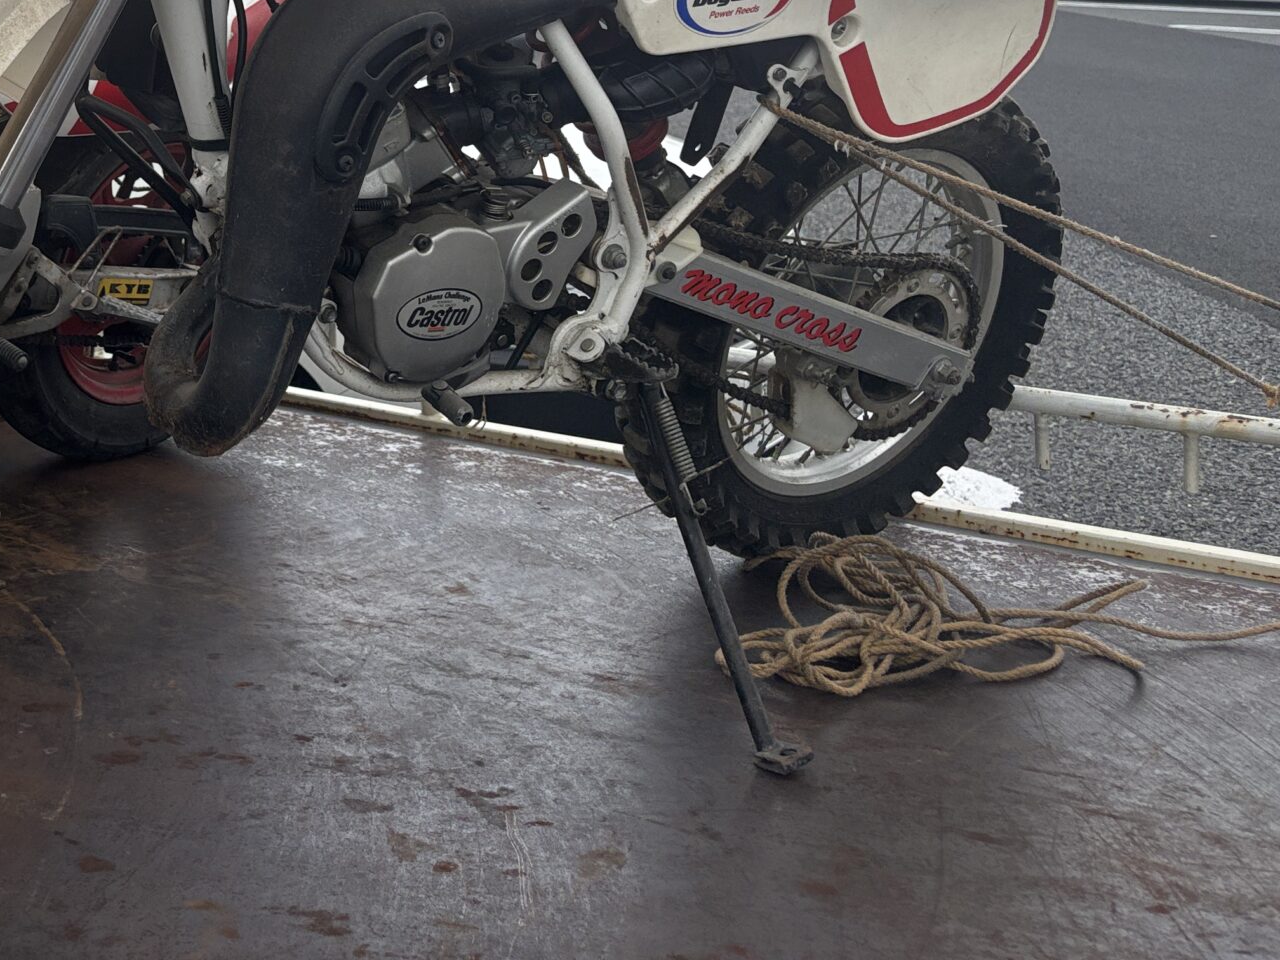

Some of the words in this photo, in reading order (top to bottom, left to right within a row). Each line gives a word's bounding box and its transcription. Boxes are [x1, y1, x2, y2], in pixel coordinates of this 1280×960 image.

[708, 9, 735, 20] Power
[734, 4, 761, 16] Reeds
[406, 304, 475, 328] Castrol
[774, 305, 863, 353] cross
